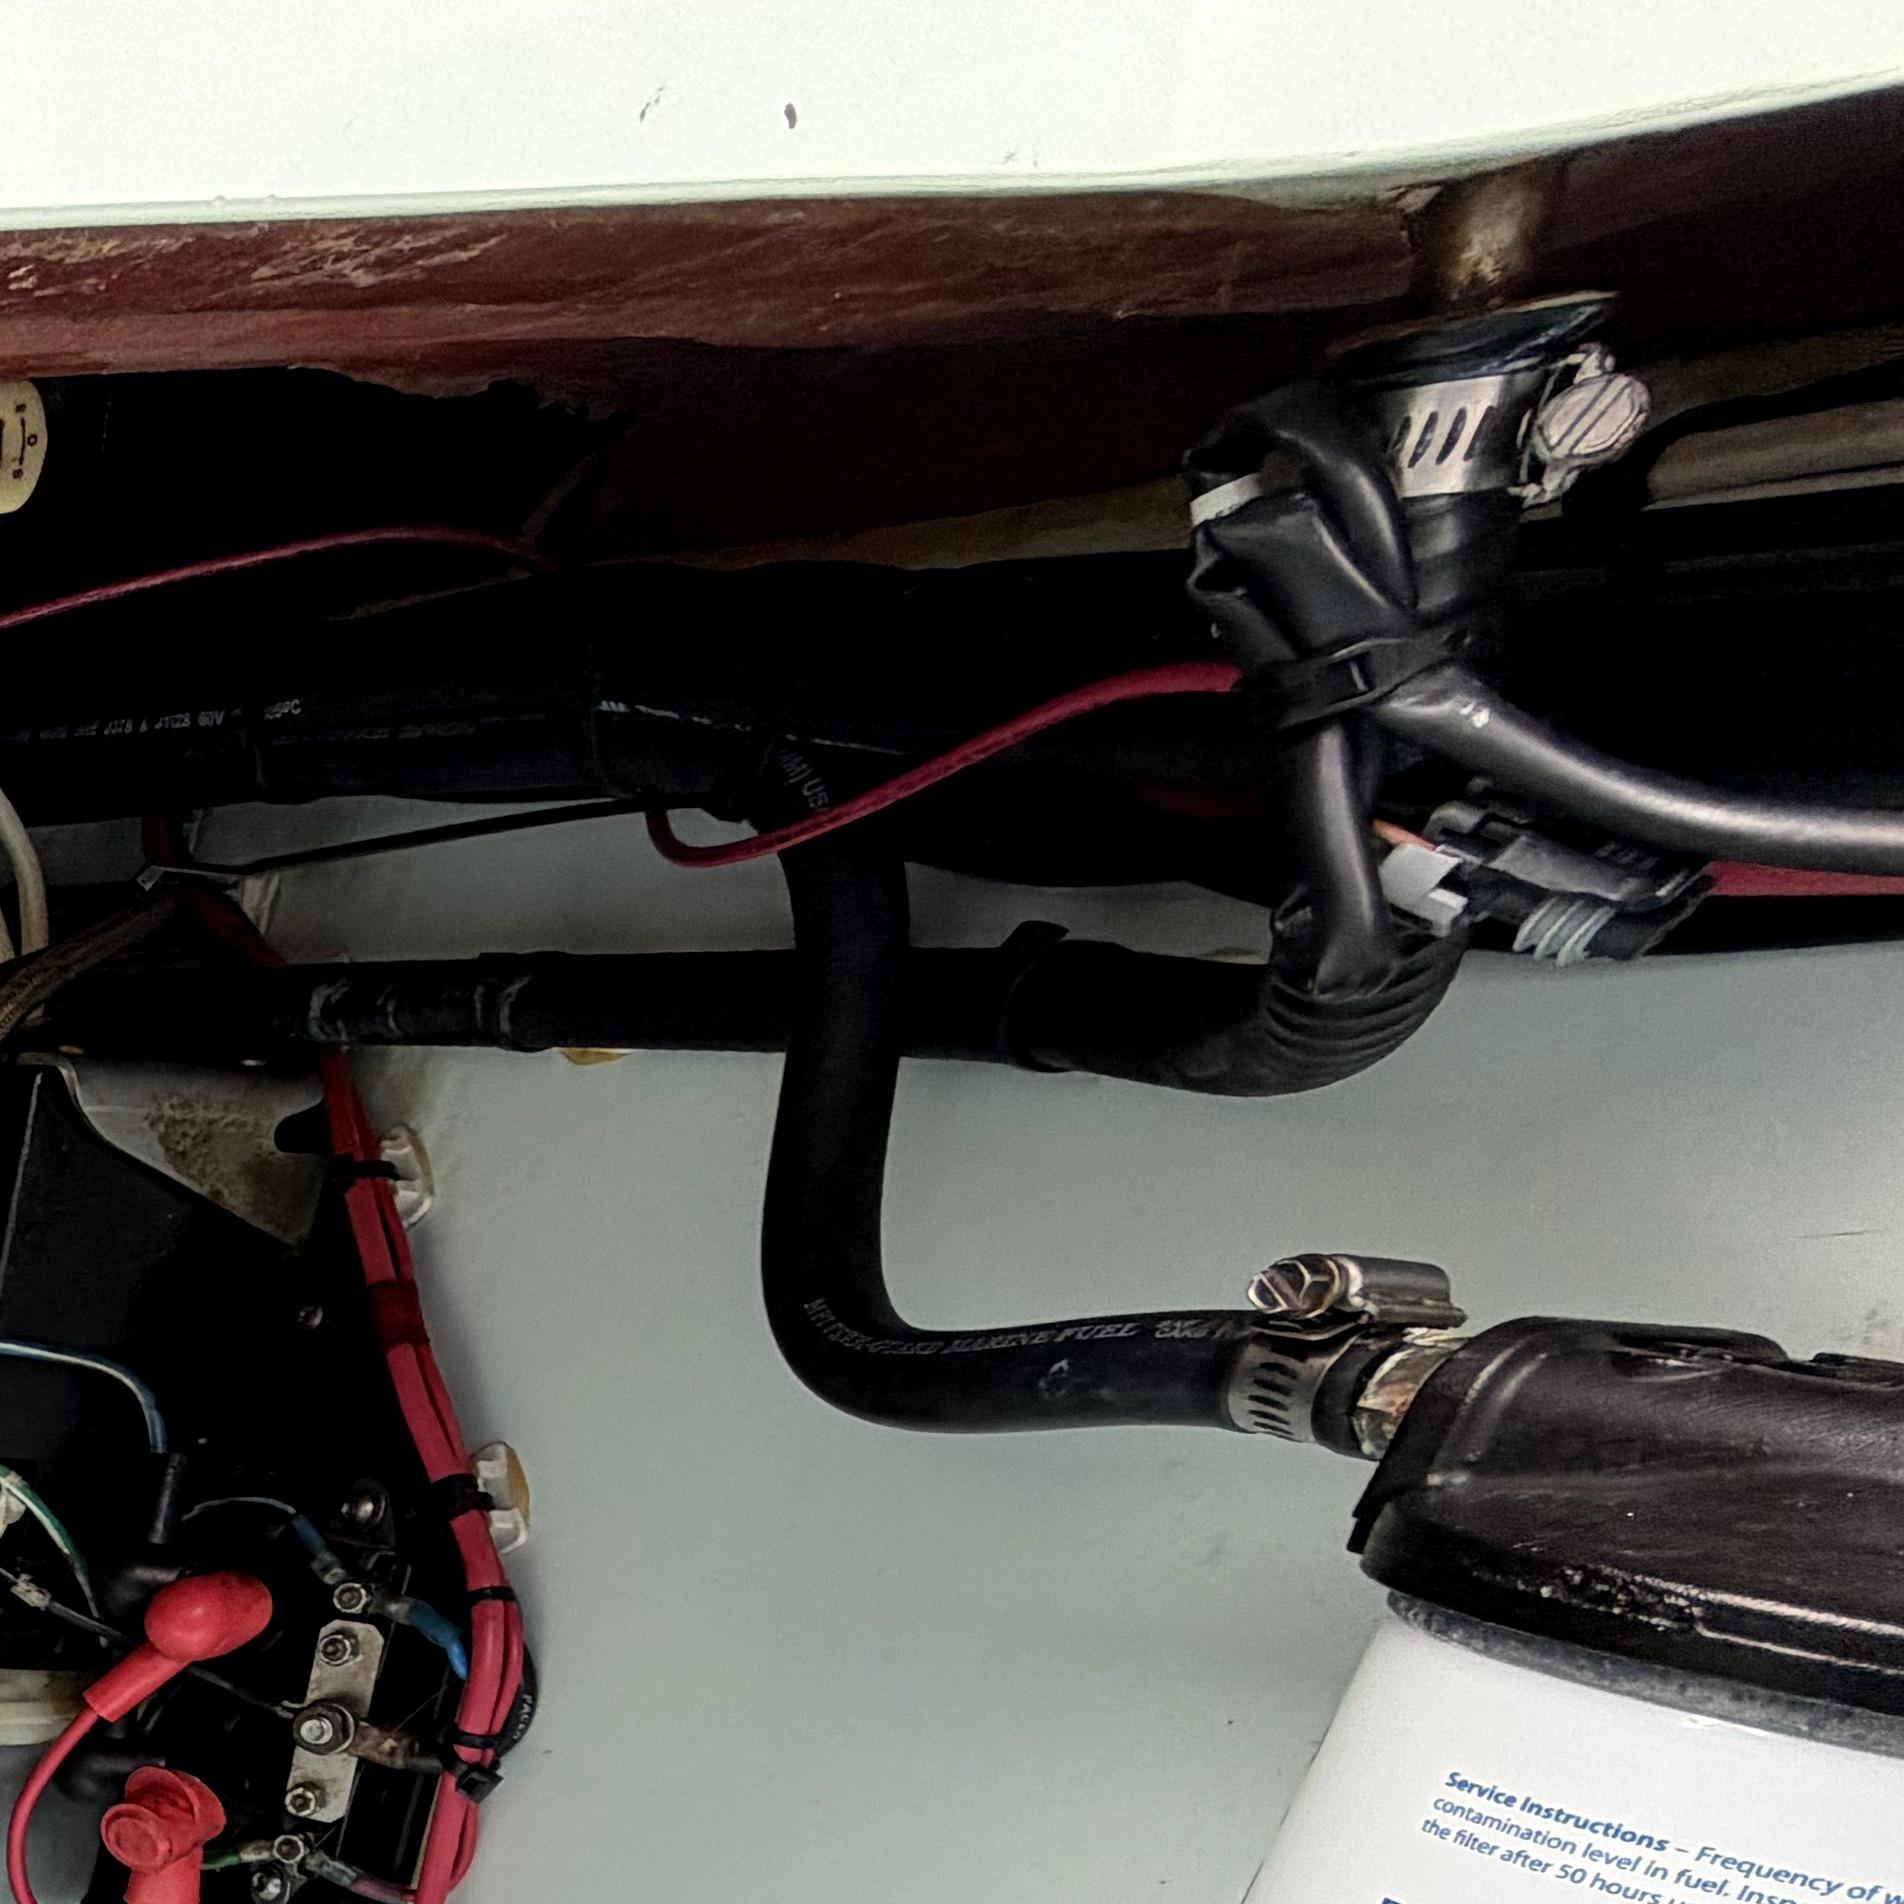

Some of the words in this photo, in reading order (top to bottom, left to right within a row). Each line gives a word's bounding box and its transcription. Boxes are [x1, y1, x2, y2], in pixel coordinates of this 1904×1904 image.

[1421, 1819, 1451, 1840] the
[1453, 1829, 1500, 1856] filter
[1500, 1850, 1554, 1873] after
[1555, 1864, 1587, 1884] 50
[1433, 1798, 1577, 1855] contamination
[1581, 1842, 1643, 1872] level
[1643, 1860, 1668, 1880] in
[1673, 1869, 1730, 1897] fuel.
[1445, 1771, 1517, 1808] Service
[1520, 1796, 1671, 1852] Instructions
[1694, 1846, 1844, 1896] Frequency
[1846, 1885, 1884, 1901] of
